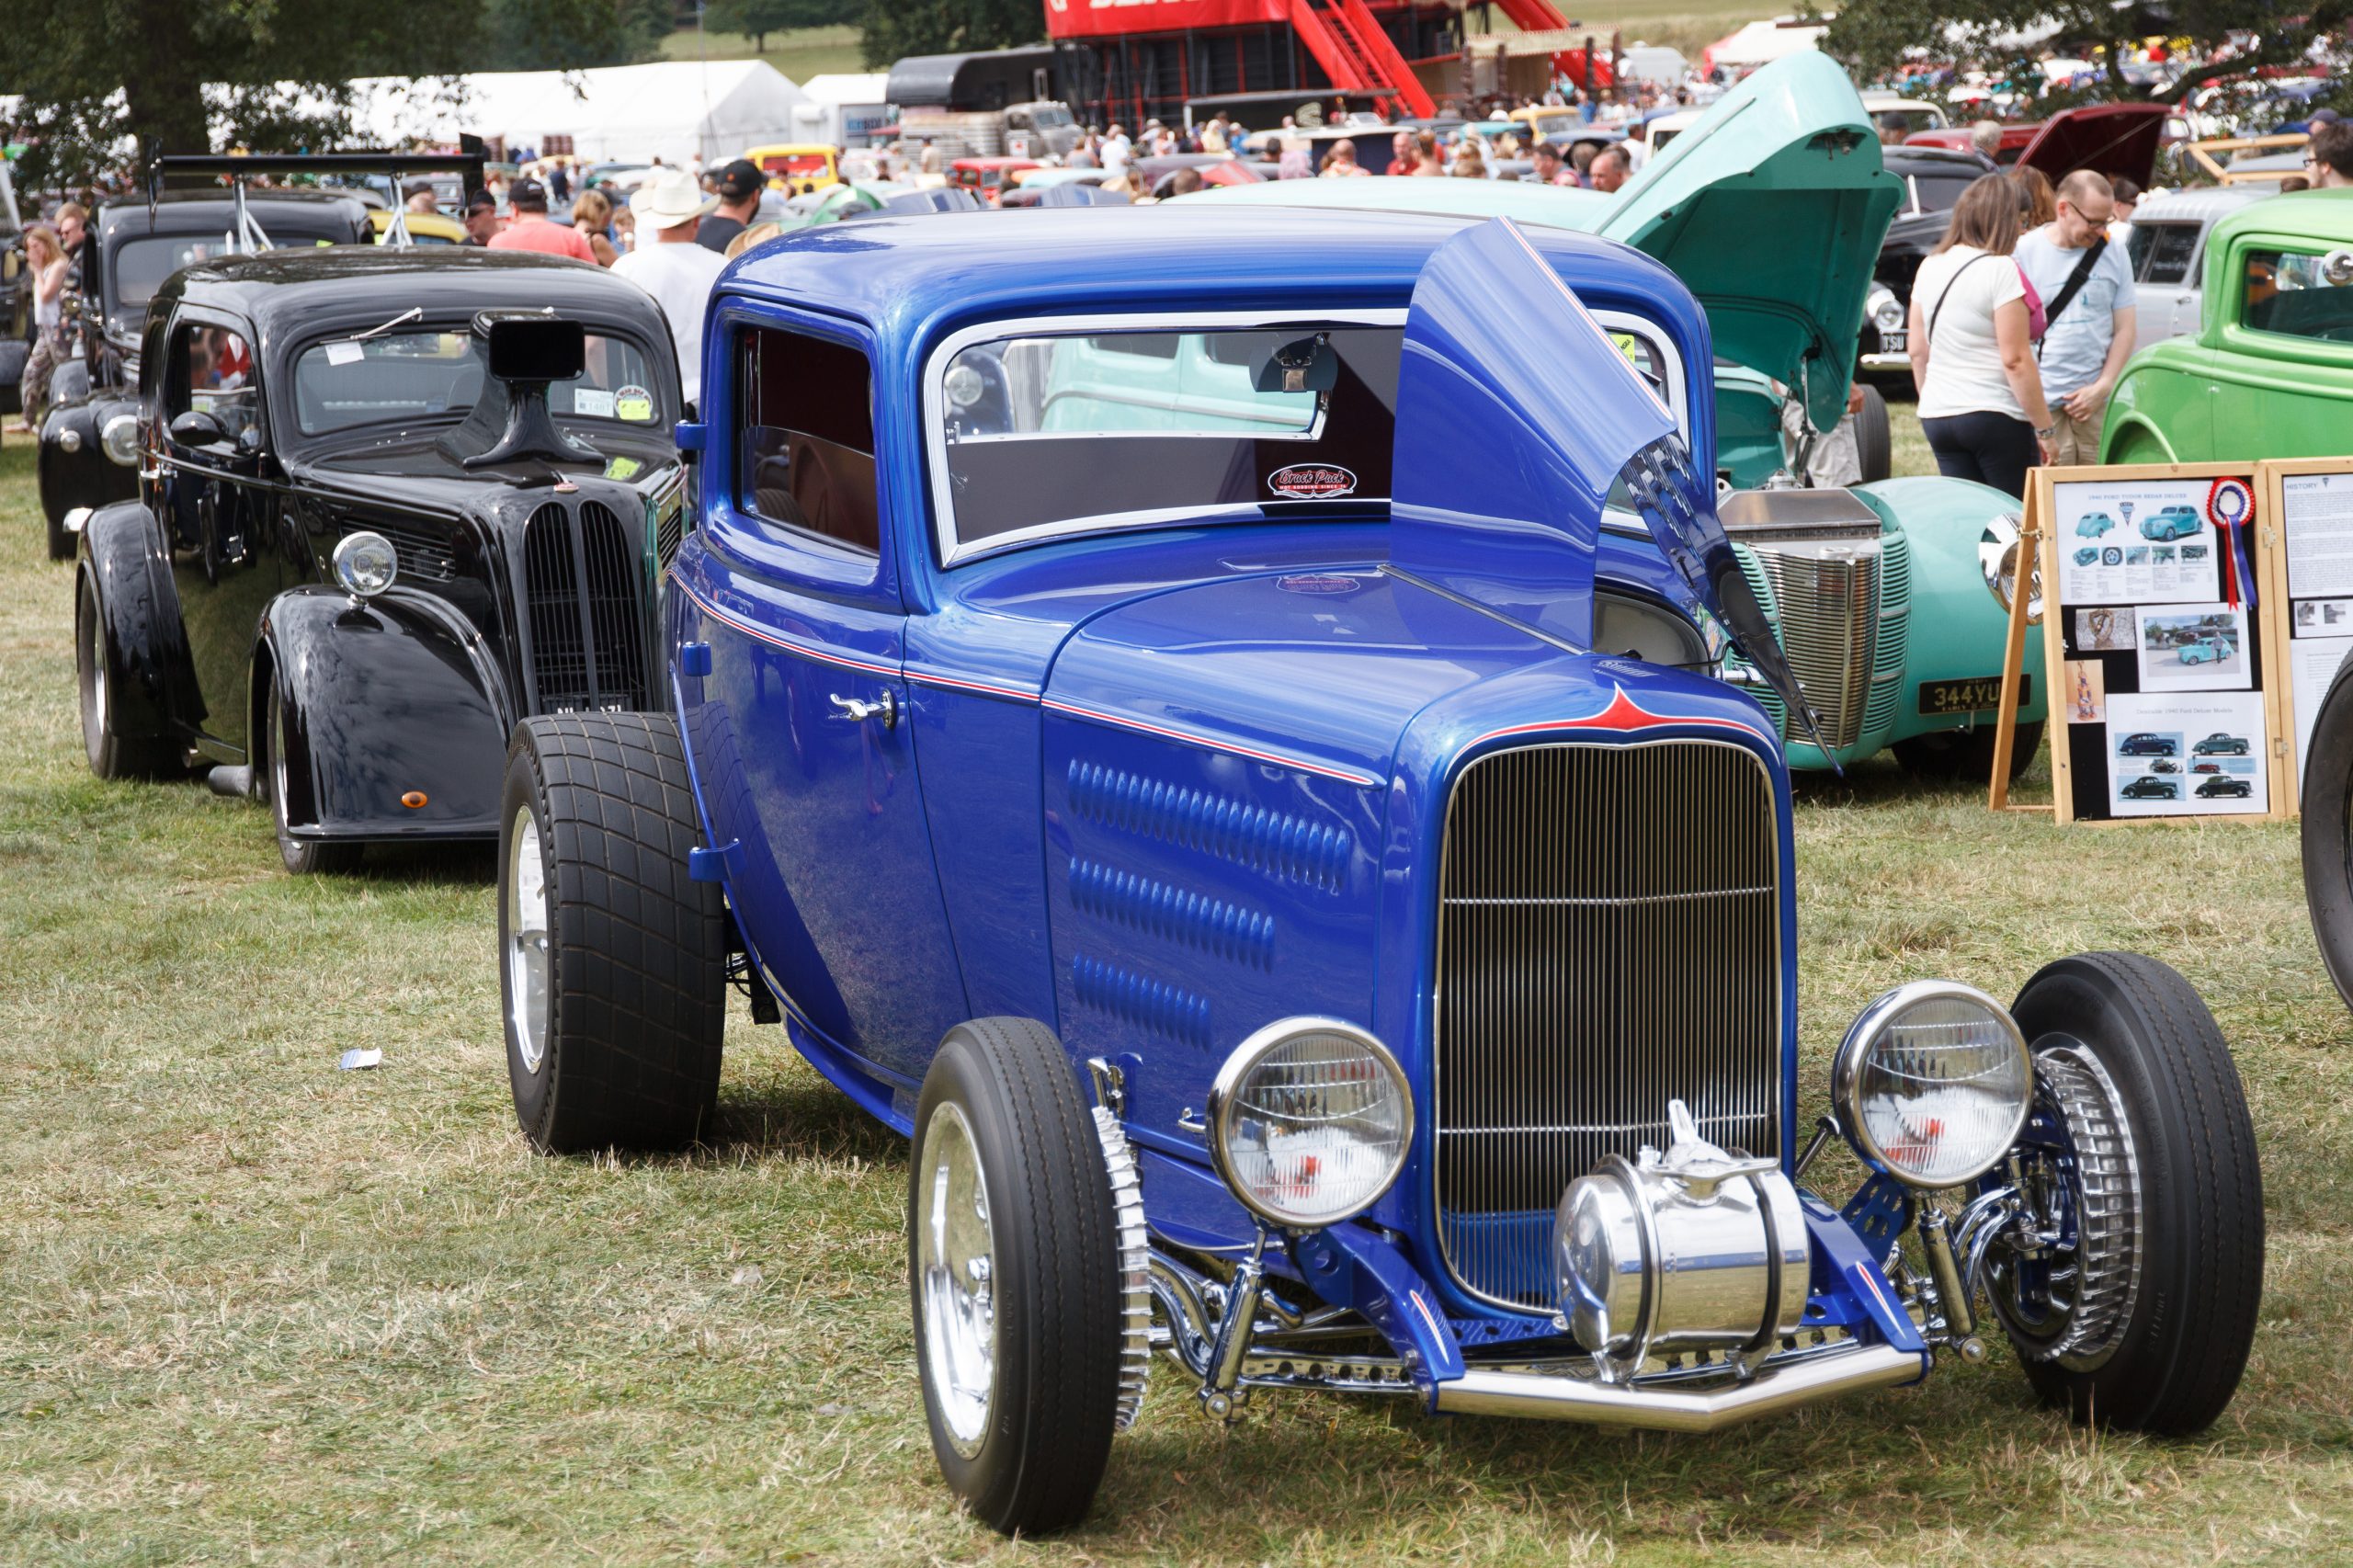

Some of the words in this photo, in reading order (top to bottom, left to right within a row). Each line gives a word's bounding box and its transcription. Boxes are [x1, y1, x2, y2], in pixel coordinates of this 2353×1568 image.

[1279, 470, 1313, 483] Brack
[1315, 470, 1344, 484] Pack
[1934, 683, 2000, 706] 344YU
